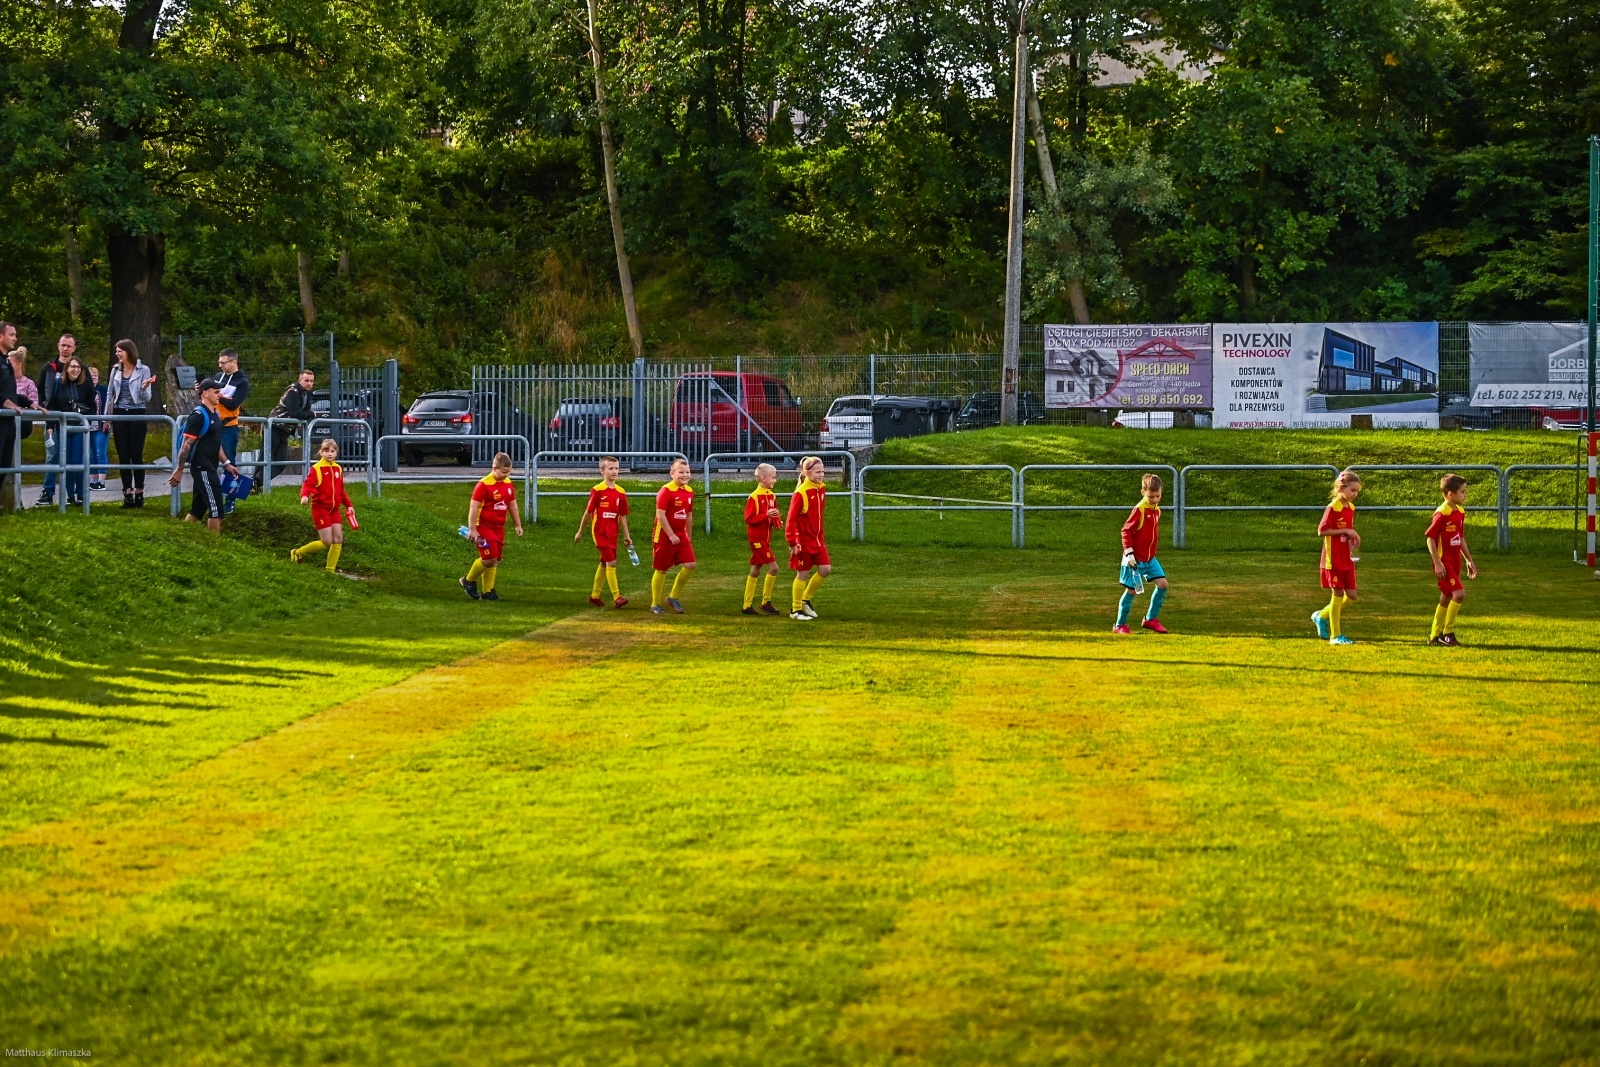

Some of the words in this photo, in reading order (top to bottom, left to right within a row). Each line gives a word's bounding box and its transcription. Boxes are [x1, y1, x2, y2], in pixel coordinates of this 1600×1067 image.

[1048, 328, 1083, 338] USŁUGI
[1086, 328, 1143, 338] CIESIELSKO
[1151, 326, 1208, 337] DEKARSKIE
[1048, 338, 1078, 347] DOMY
[1080, 338, 1102, 348] POD
[1104, 338, 1136, 348] KLUCZ
[1222, 333, 1292, 348] PIVEXIN
[1222, 349, 1291, 358] TECHNOLOGY
[1131, 362, 1190, 376] SPEED-DACH
[1238, 366, 1276, 376] DOSTAWCA
[1230, 378, 1284, 388] KOMPONENTÓW
[1118, 394, 1134, 405] tel.
[1138, 394, 1158, 405] 698
[1160, 394, 1180, 405] 650
[1183, 394, 1203, 405] 692
[1240, 390, 1280, 401] ROZWIĄZAŃ
[1477, 390, 1494, 400] tel.
[1498, 390, 1519, 400] 602
[1521, 390, 1542, 400] 252
[1229, 403, 1242, 412] DLA
[1244, 403, 1285, 412] PRZEMYSŁU
[1450, 578, 1456, 586] 9
